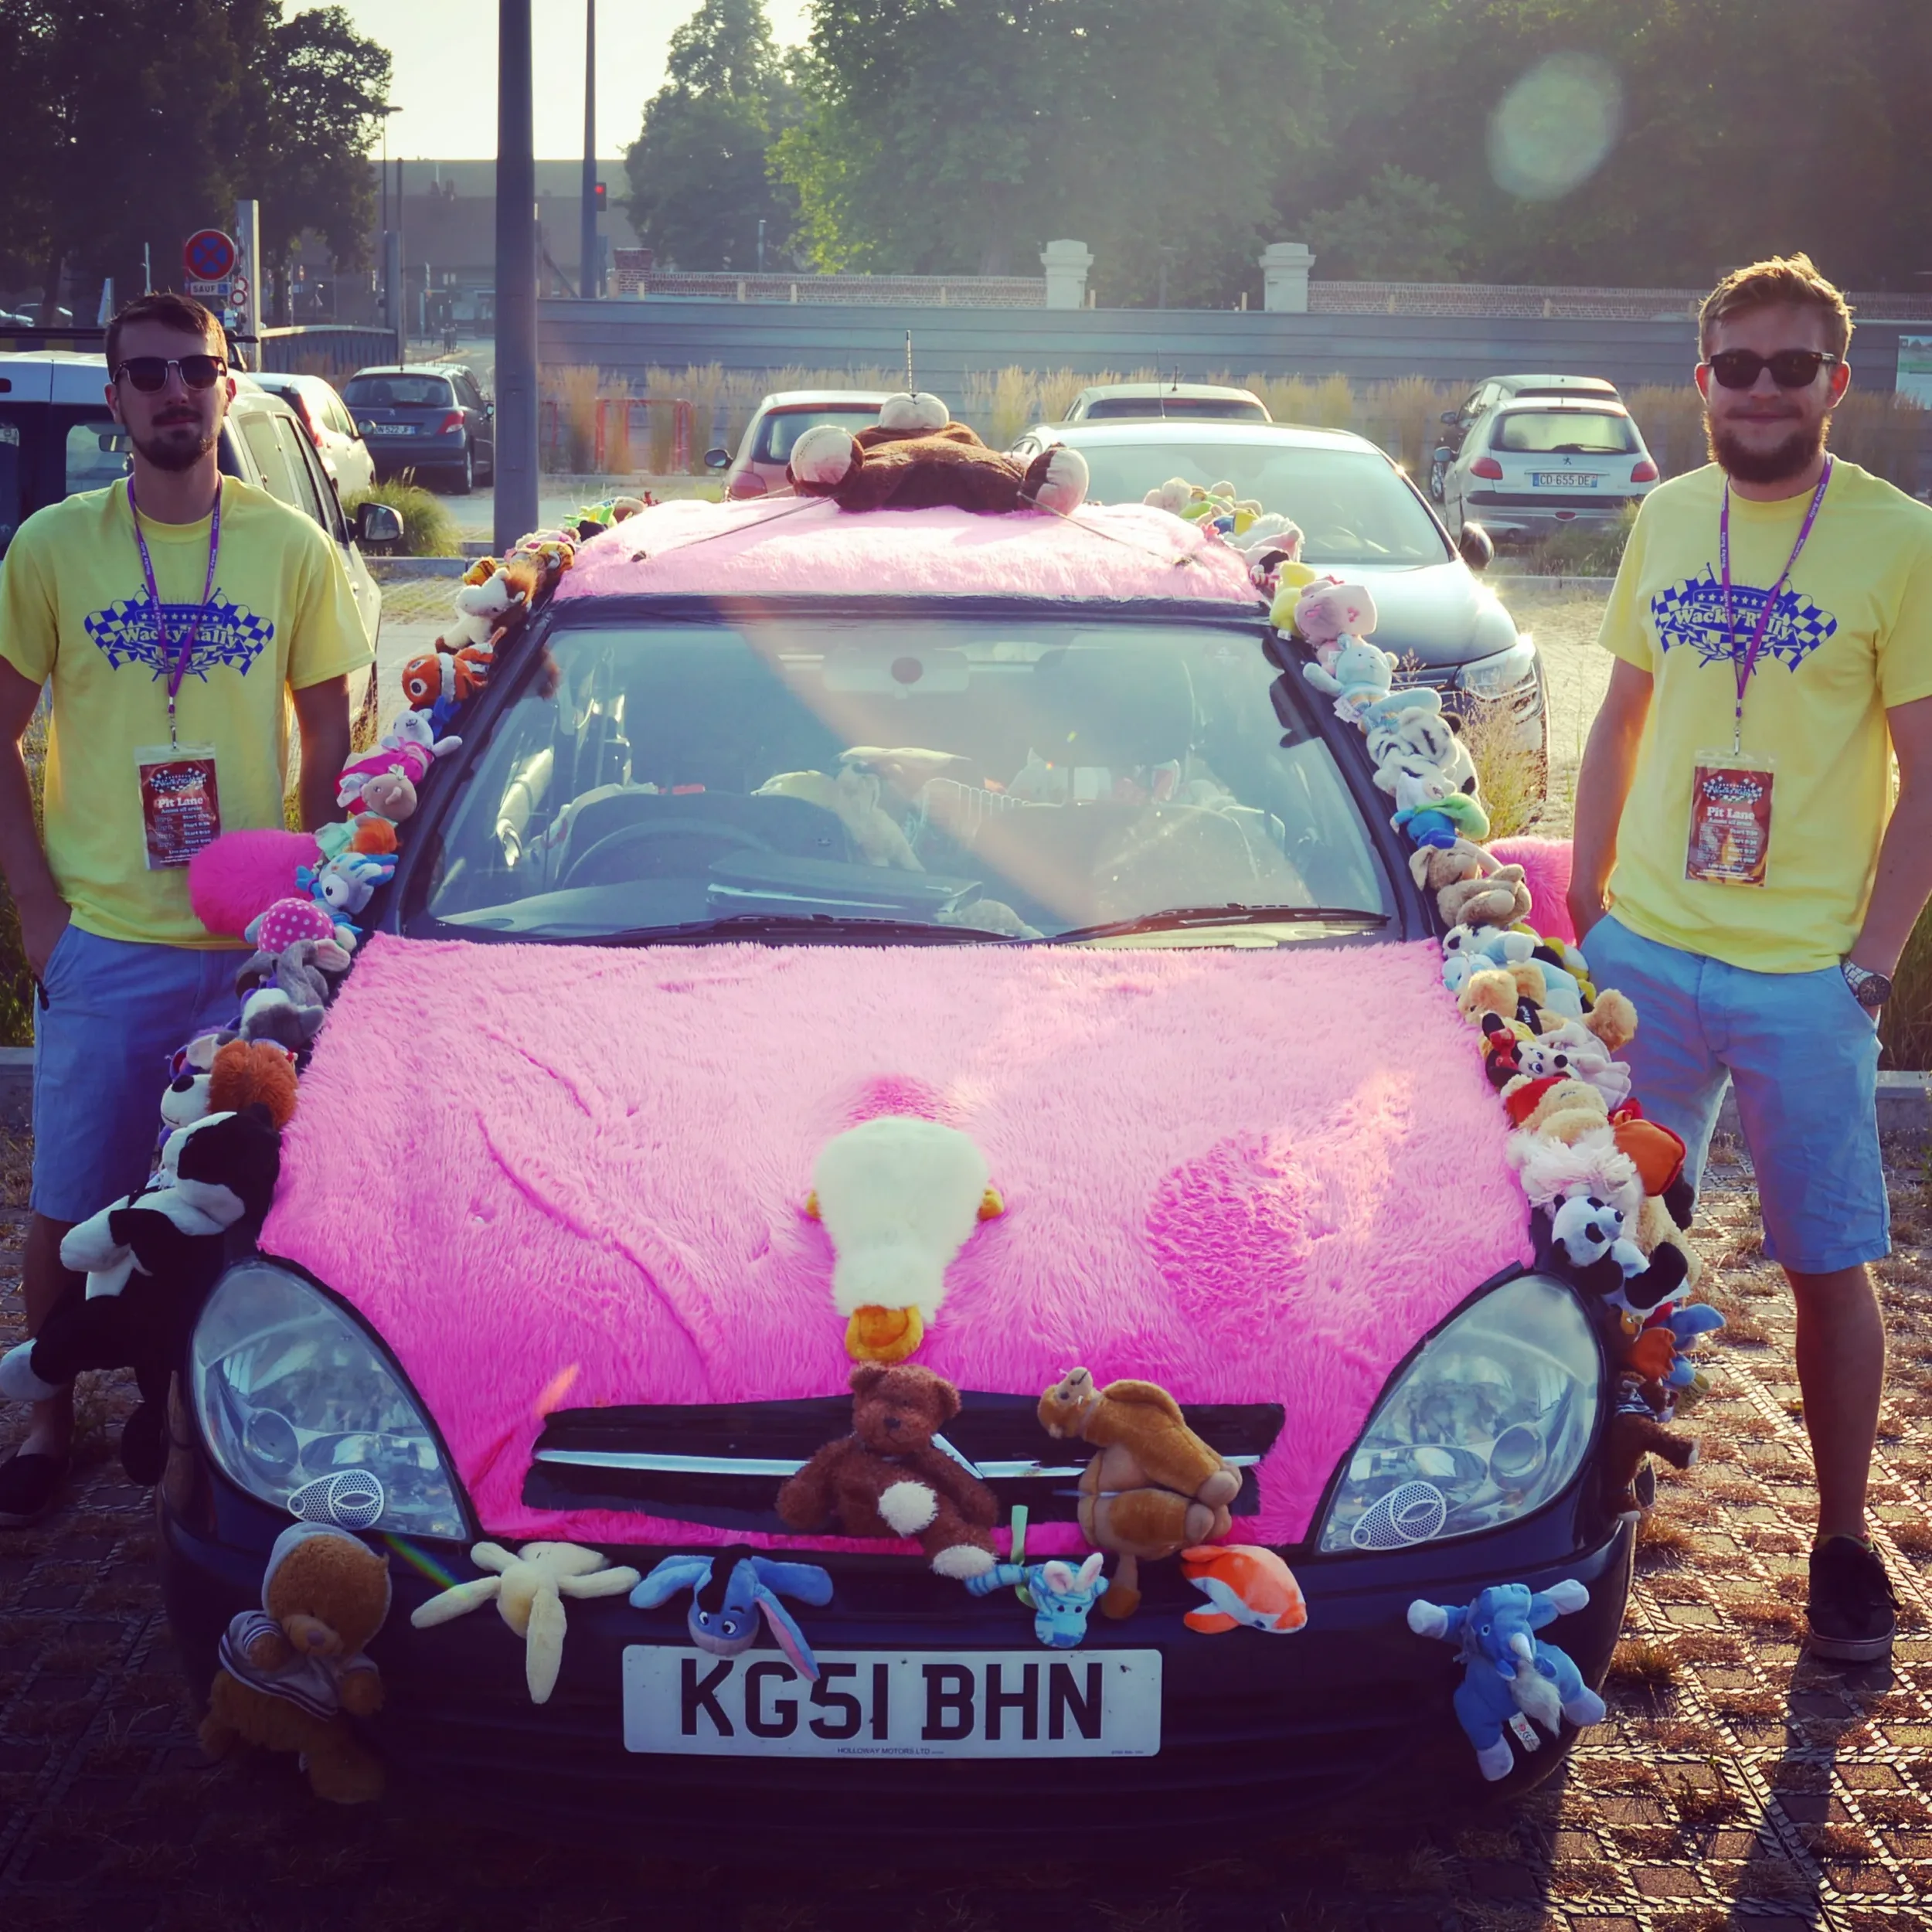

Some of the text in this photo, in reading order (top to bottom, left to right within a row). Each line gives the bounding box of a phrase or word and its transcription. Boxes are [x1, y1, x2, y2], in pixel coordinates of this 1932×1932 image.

[1744, 611, 1794, 641] Rlly
[120, 627, 239, 648] Wacy ally
[158, 797, 203, 808] Pit Lane
[1707, 807, 1755, 820] Pit Lane
[681, 1658, 1103, 1740] KG51 BHN
